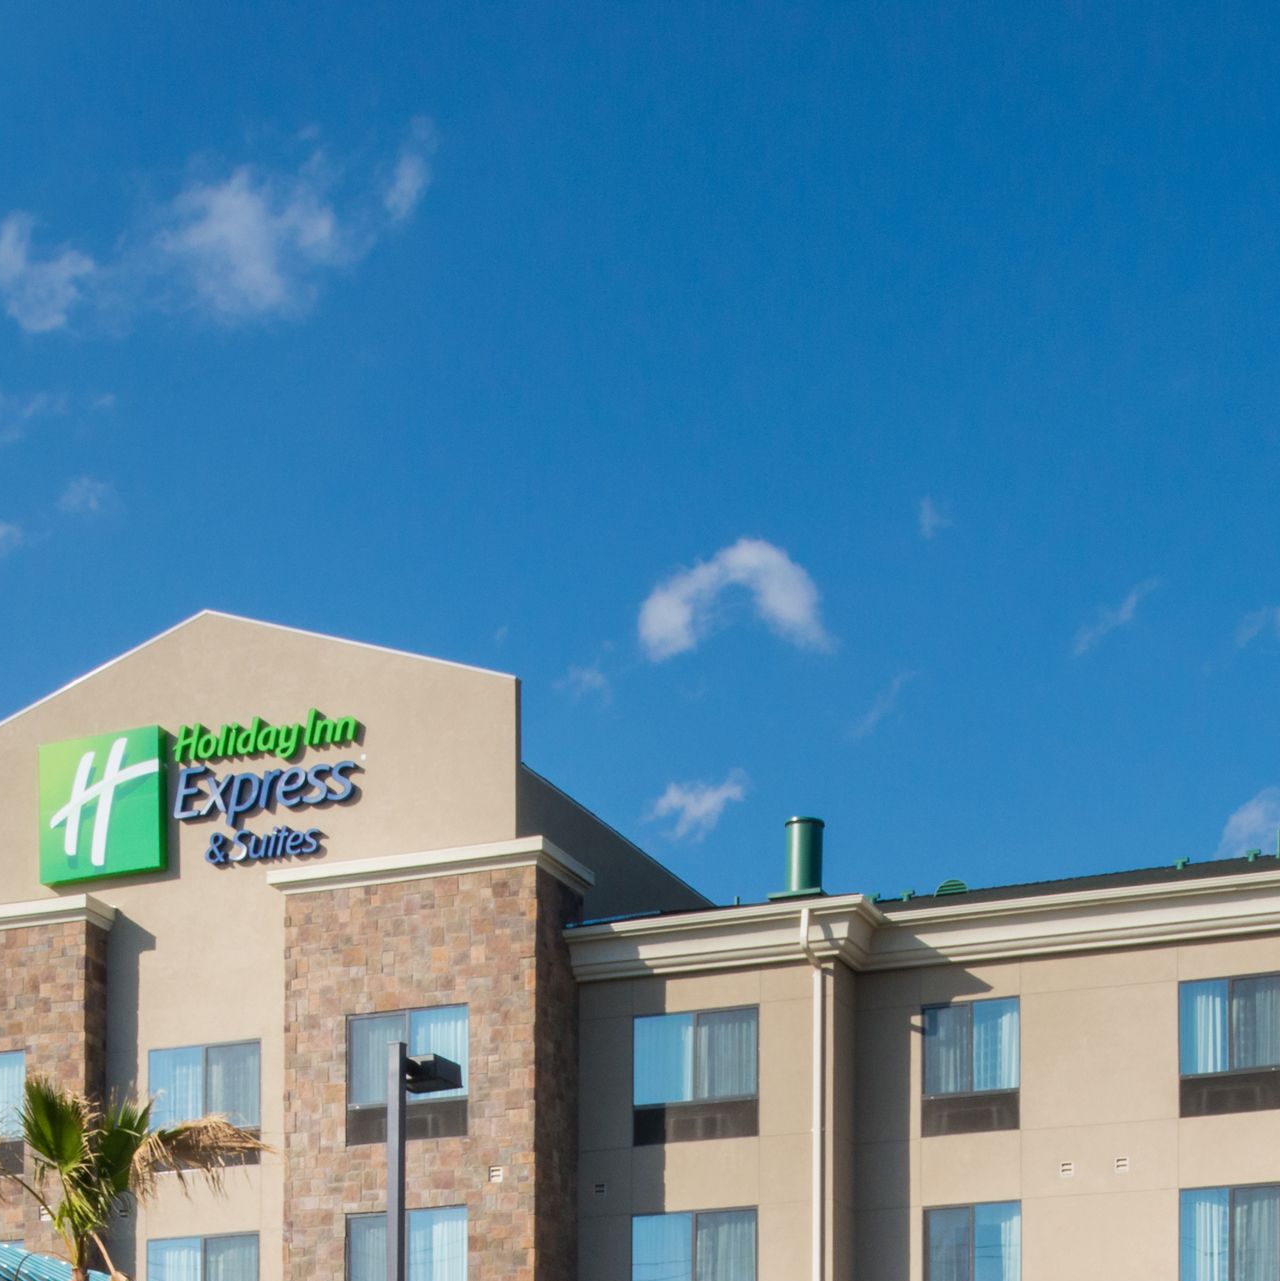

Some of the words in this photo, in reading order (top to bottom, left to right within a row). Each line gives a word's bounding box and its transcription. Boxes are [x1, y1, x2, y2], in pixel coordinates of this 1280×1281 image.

[173, 716, 303, 760] Holiday
[304, 707, 358, 746] Inn
[173, 760, 357, 827] Express
[205, 832, 226, 864] &
[229, 825, 322, 861] Suites
